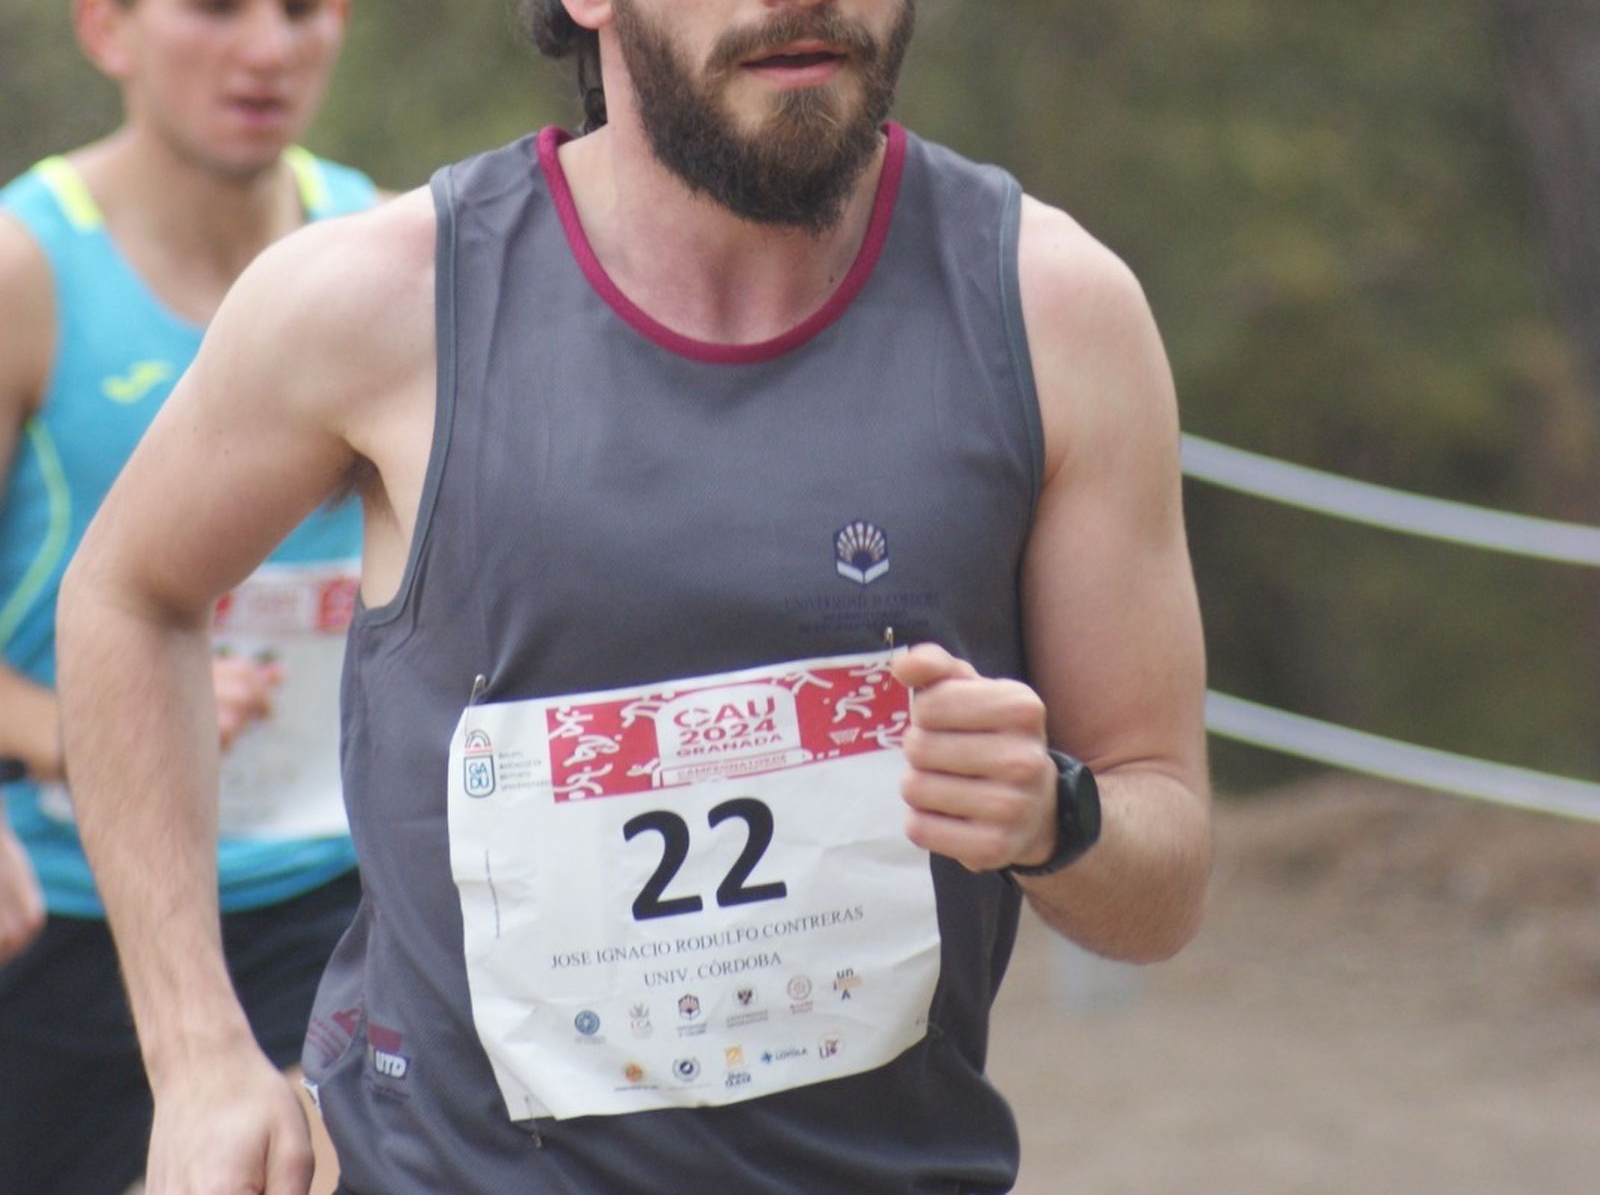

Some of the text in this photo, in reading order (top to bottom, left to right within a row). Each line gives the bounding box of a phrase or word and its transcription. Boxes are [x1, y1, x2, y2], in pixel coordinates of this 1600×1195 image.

[673, 696, 776, 727] CAU
[676, 734, 782, 757] GRANADA
[679, 717, 776, 746] 2024
[622, 797, 787, 921] 22
[551, 906, 864, 969] JOSE IGNACIO RODULFO CONTRERAS
[696, 952, 782, 980] CÓRDOBA
